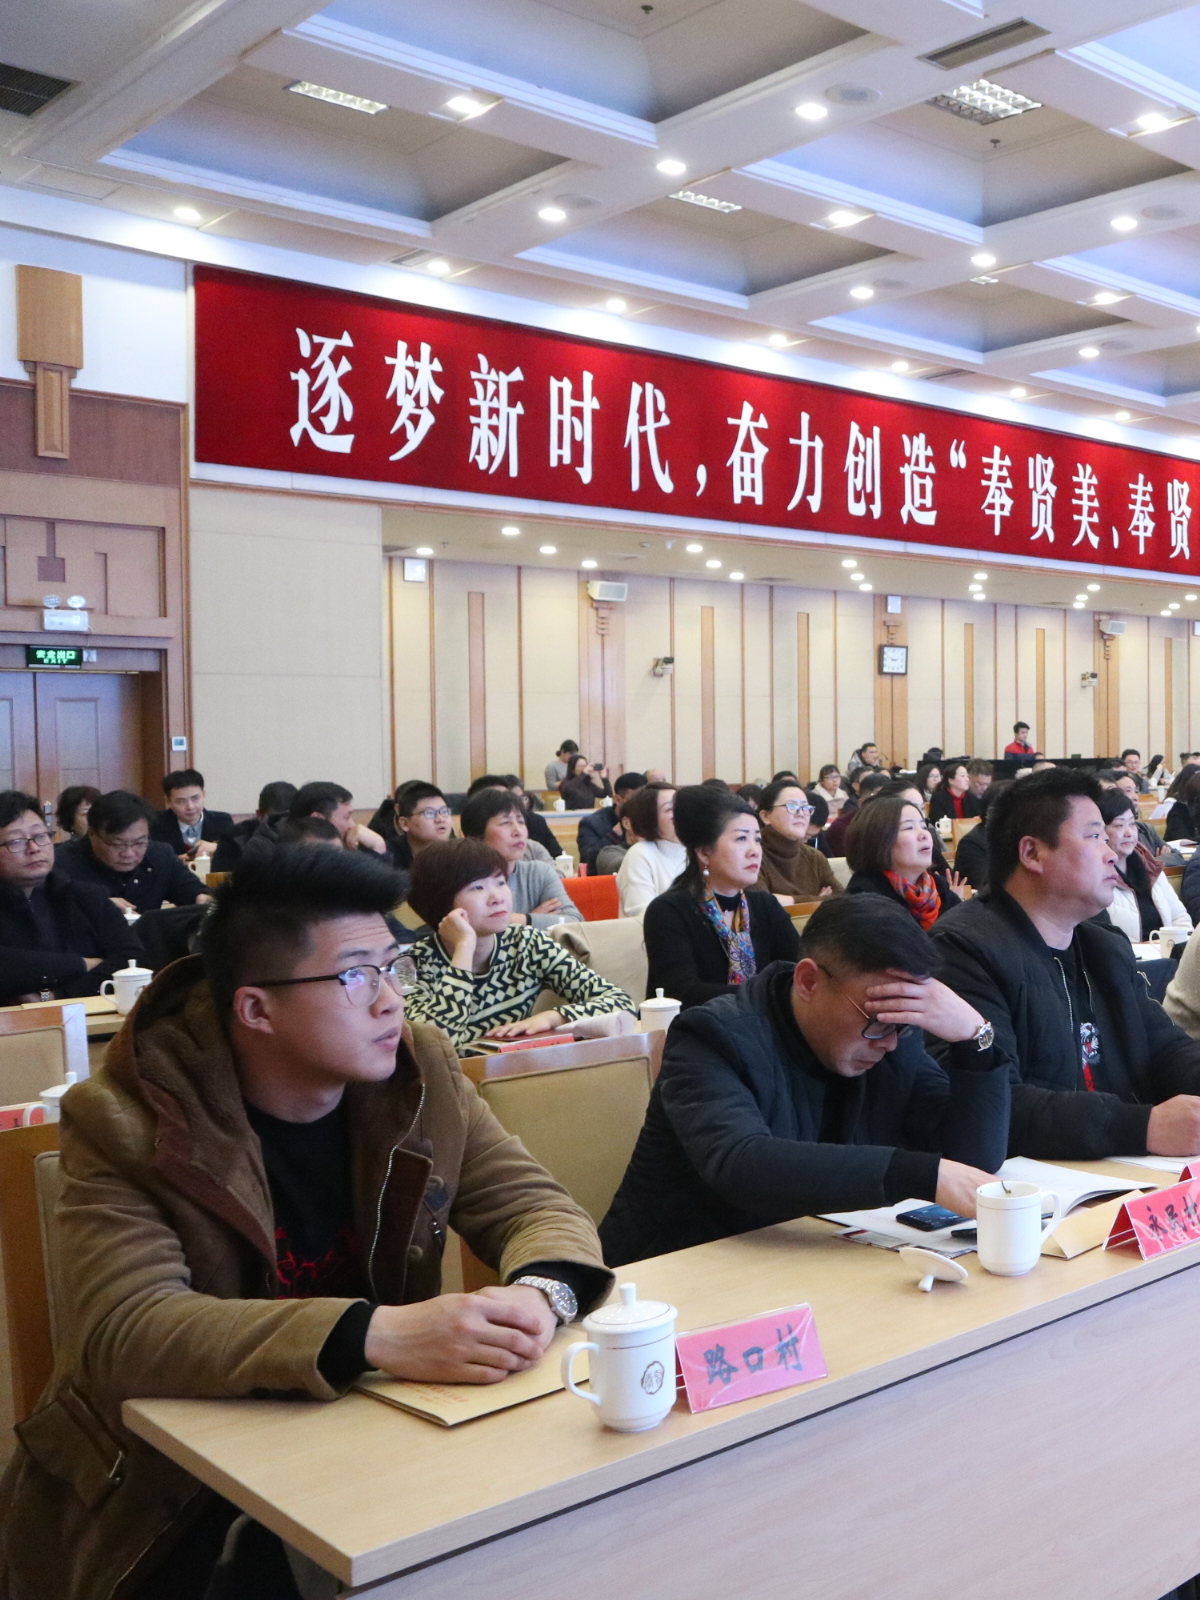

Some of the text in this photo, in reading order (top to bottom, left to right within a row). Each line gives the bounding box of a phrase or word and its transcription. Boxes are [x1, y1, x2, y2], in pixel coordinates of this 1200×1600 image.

[36, 650, 76, 659] 安全出口
[703, 1324, 803, 1385] 路口村
